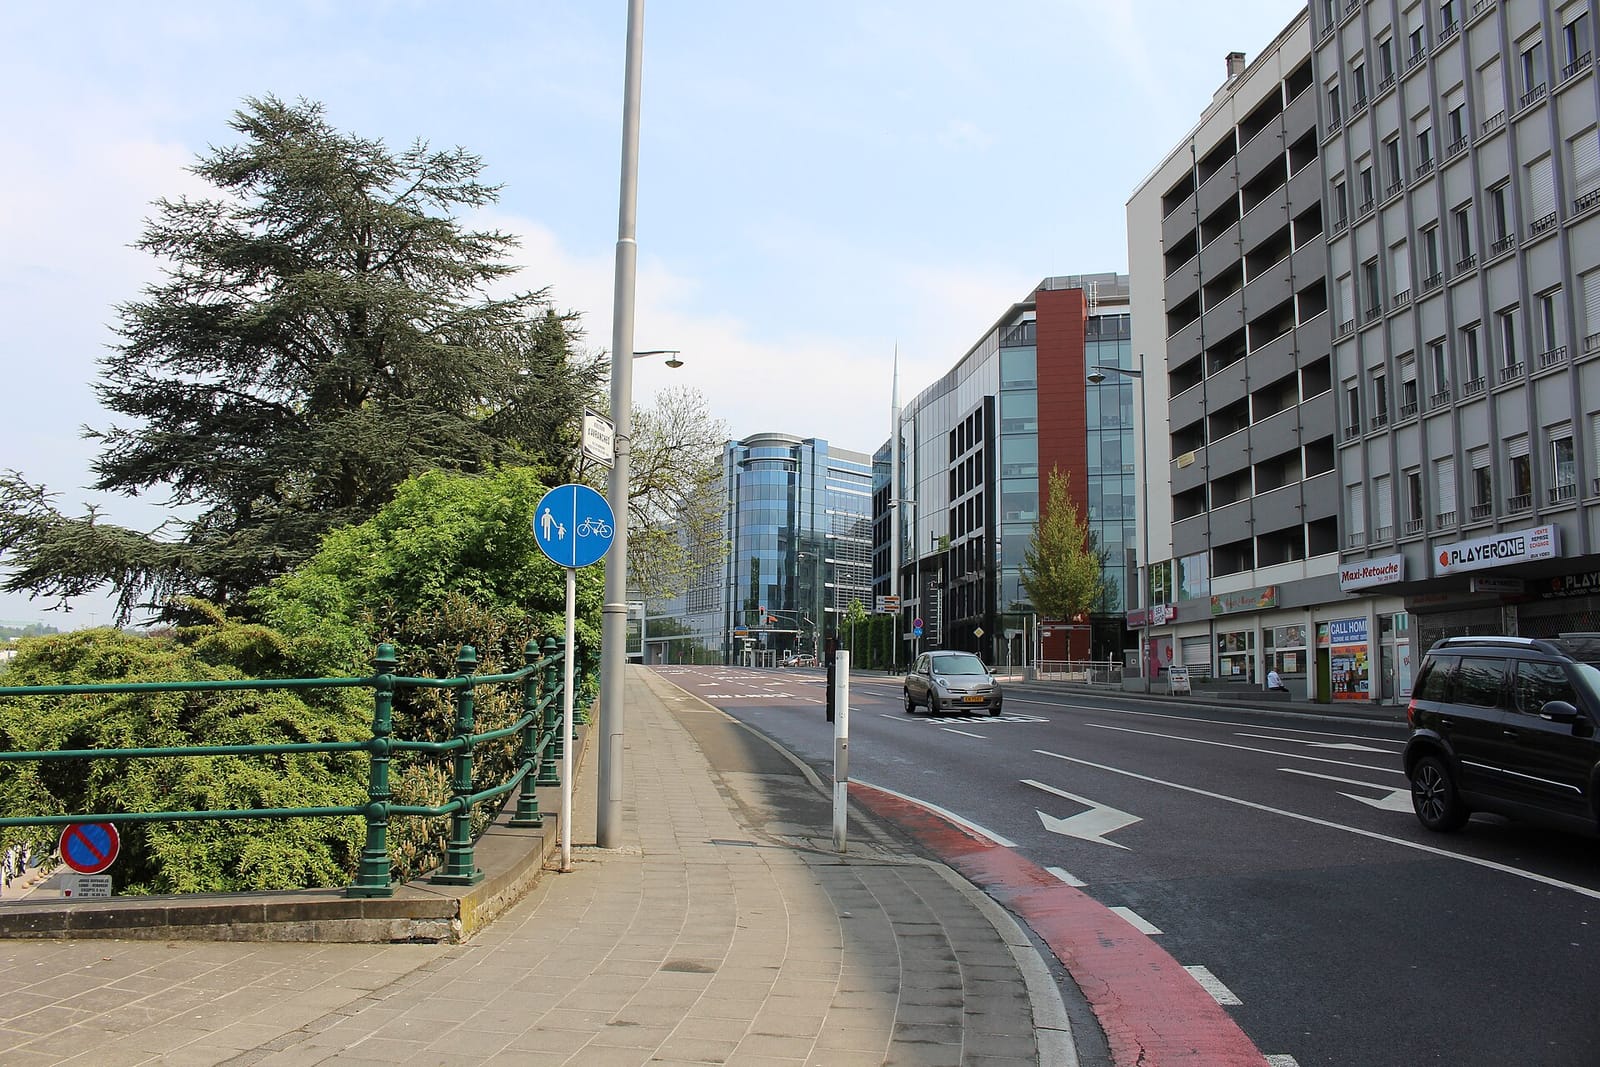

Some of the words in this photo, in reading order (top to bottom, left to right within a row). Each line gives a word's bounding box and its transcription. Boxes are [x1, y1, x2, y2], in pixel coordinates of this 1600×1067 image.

[1452, 536, 1525, 565] PLAYERONE
[1341, 562, 1399, 584] Maxi-Retouche
[1155, 606, 1163, 615] SEX
[1154, 614, 1165, 625] SHOP
[1331, 622, 1348, 635] CALL
